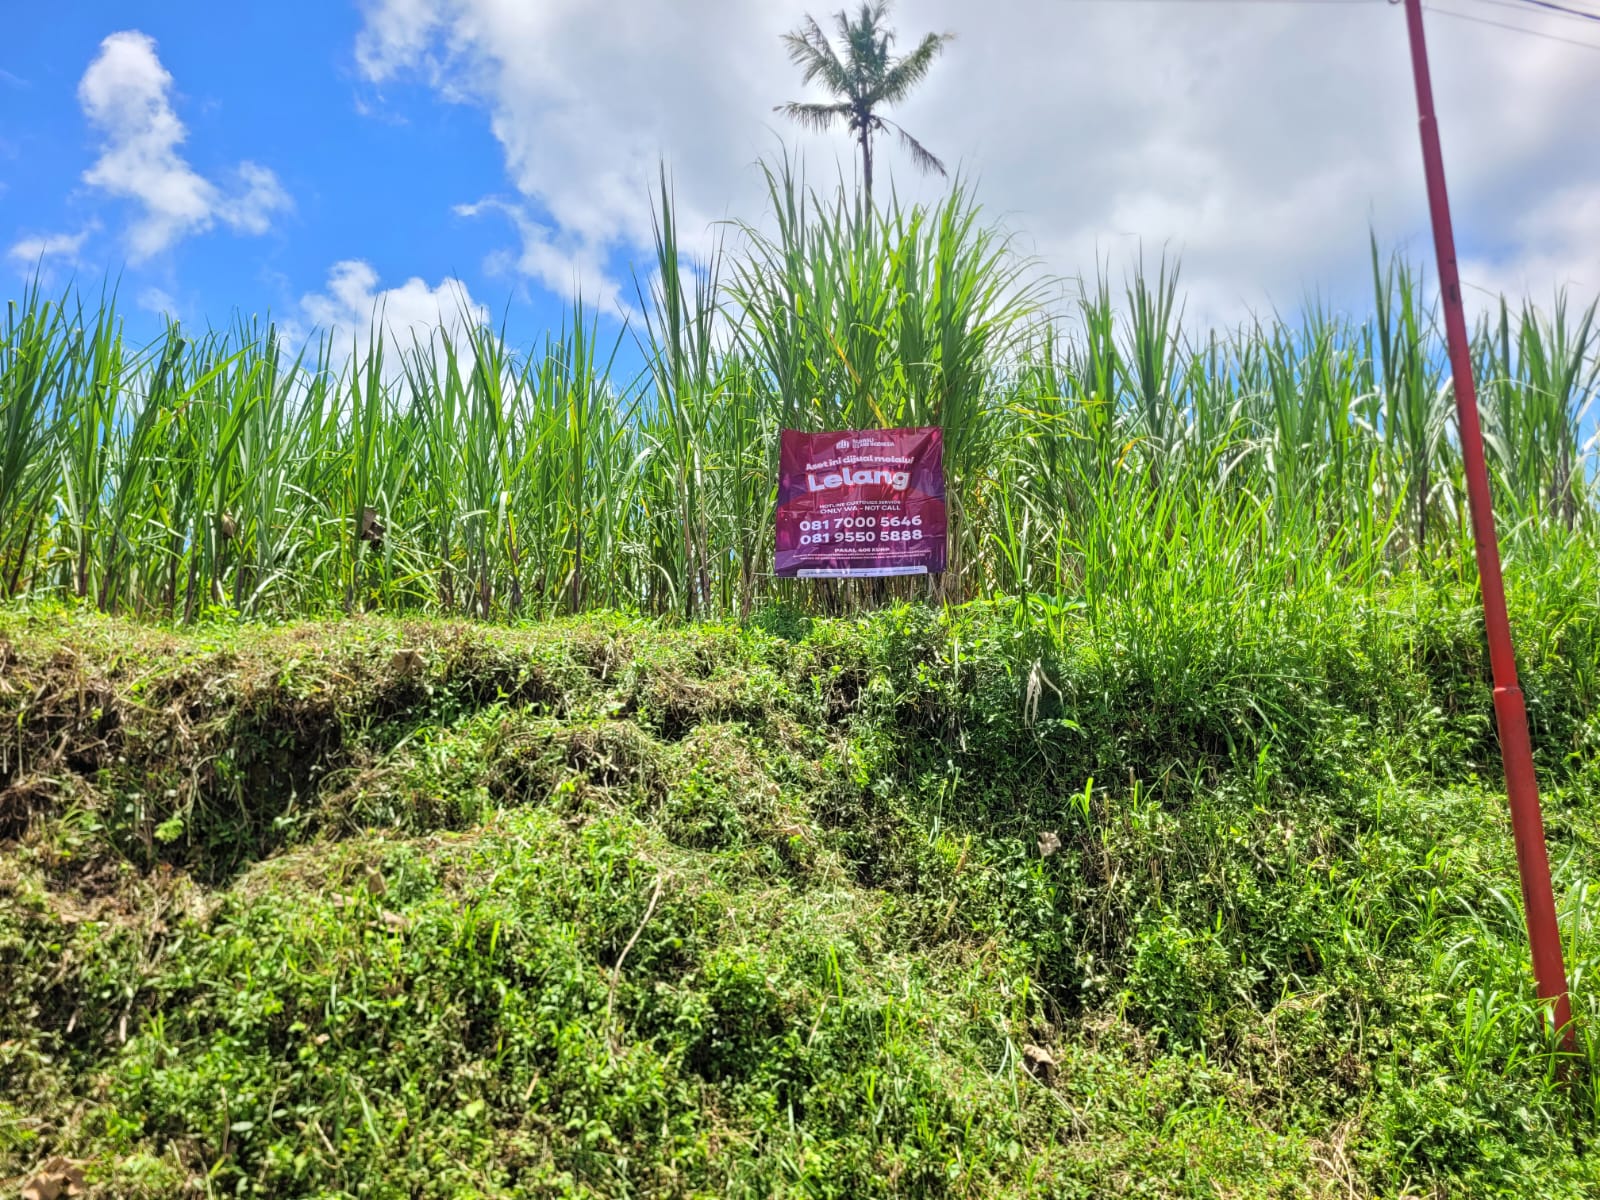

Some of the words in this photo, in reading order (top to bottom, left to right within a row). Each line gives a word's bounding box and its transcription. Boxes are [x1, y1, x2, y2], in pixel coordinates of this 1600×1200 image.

[806, 461, 828, 471] Aset
[829, 457, 842, 467] ini
[843, 454, 873, 464] dijual
[874, 455, 915, 465] melalui
[807, 467, 910, 492] Lelang
[799, 519, 829, 532] 081
[834, 516, 876, 529] 7000
[880, 514, 922, 527] 5646
[799, 533, 830, 545] 081
[834, 531, 876, 543] 9550
[880, 529, 923, 542] 5888
